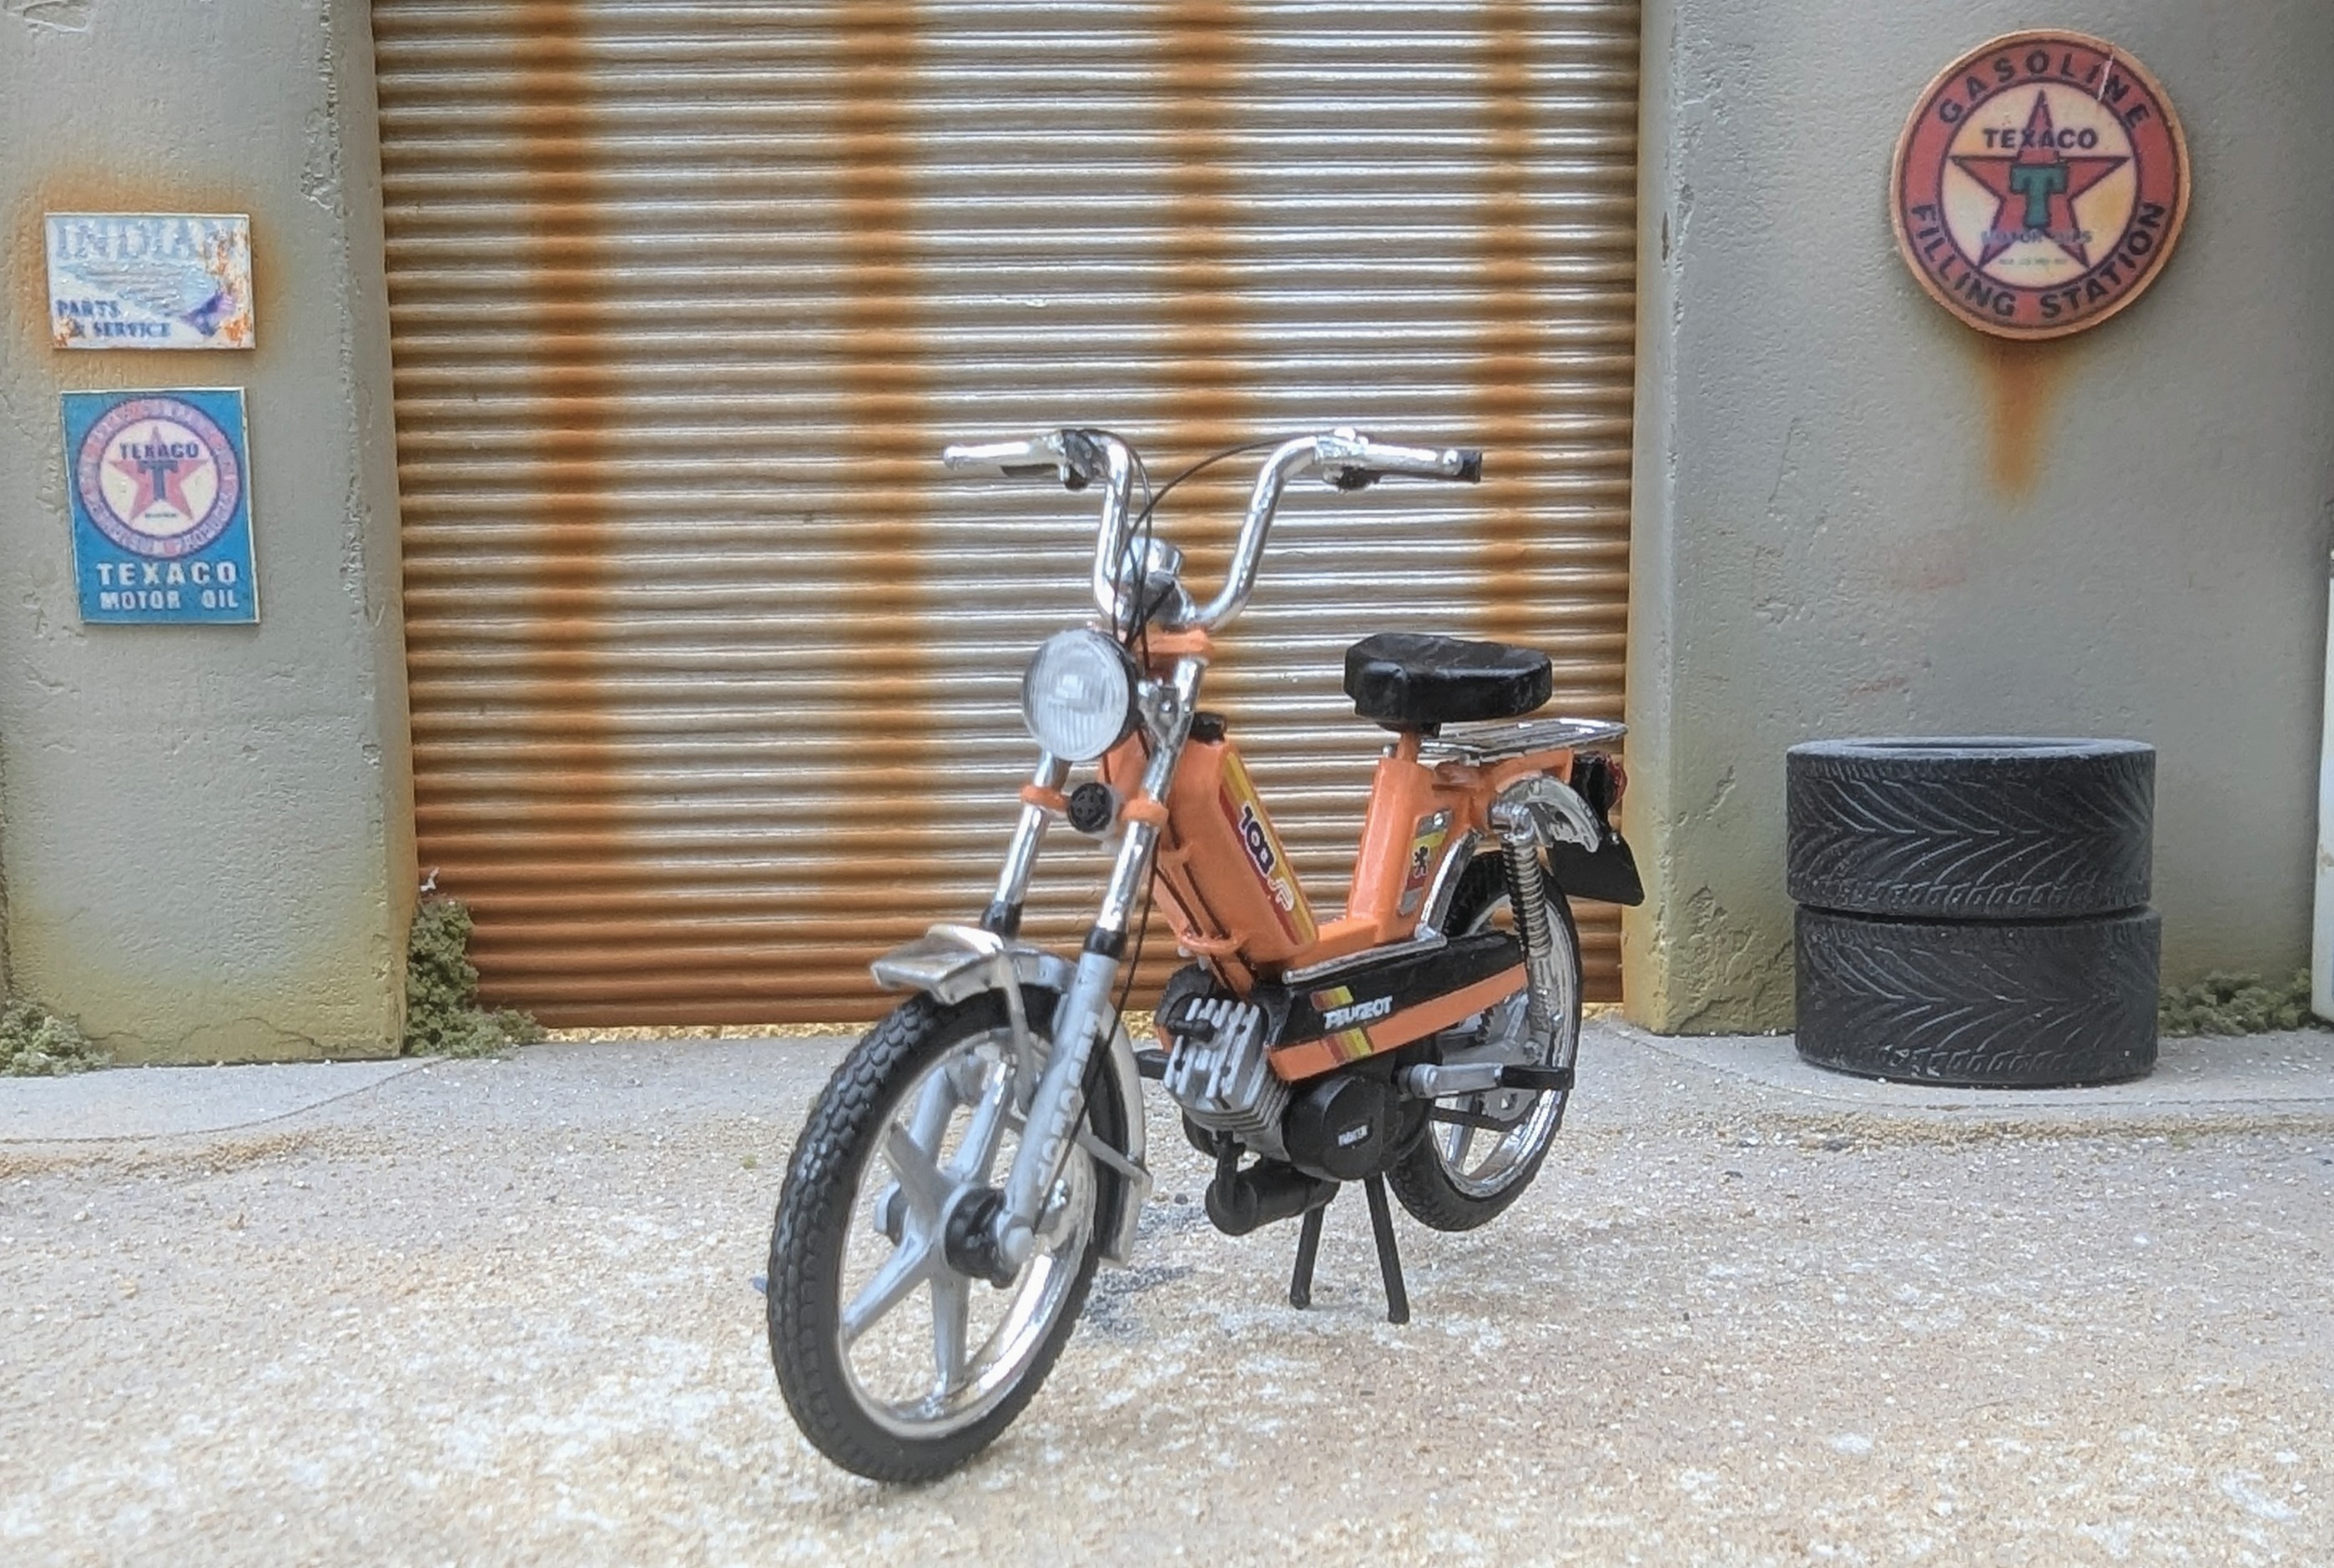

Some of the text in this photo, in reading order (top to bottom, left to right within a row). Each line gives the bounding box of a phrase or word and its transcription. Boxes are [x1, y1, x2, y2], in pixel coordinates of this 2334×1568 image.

[1938, 48, 2151, 128] GASOLINE
[1983, 127, 2100, 149] TEXACO
[2009, 163, 2070, 230] T
[1911, 202, 2166, 318] FILLING STATION
[56, 300, 121, 317] PARTS
[93, 321, 171, 337] SERVICE
[119, 442, 200, 459] TEXACO
[96, 561, 237, 586] TEXACO
[99, 588, 239, 611] MOTOR OIL
